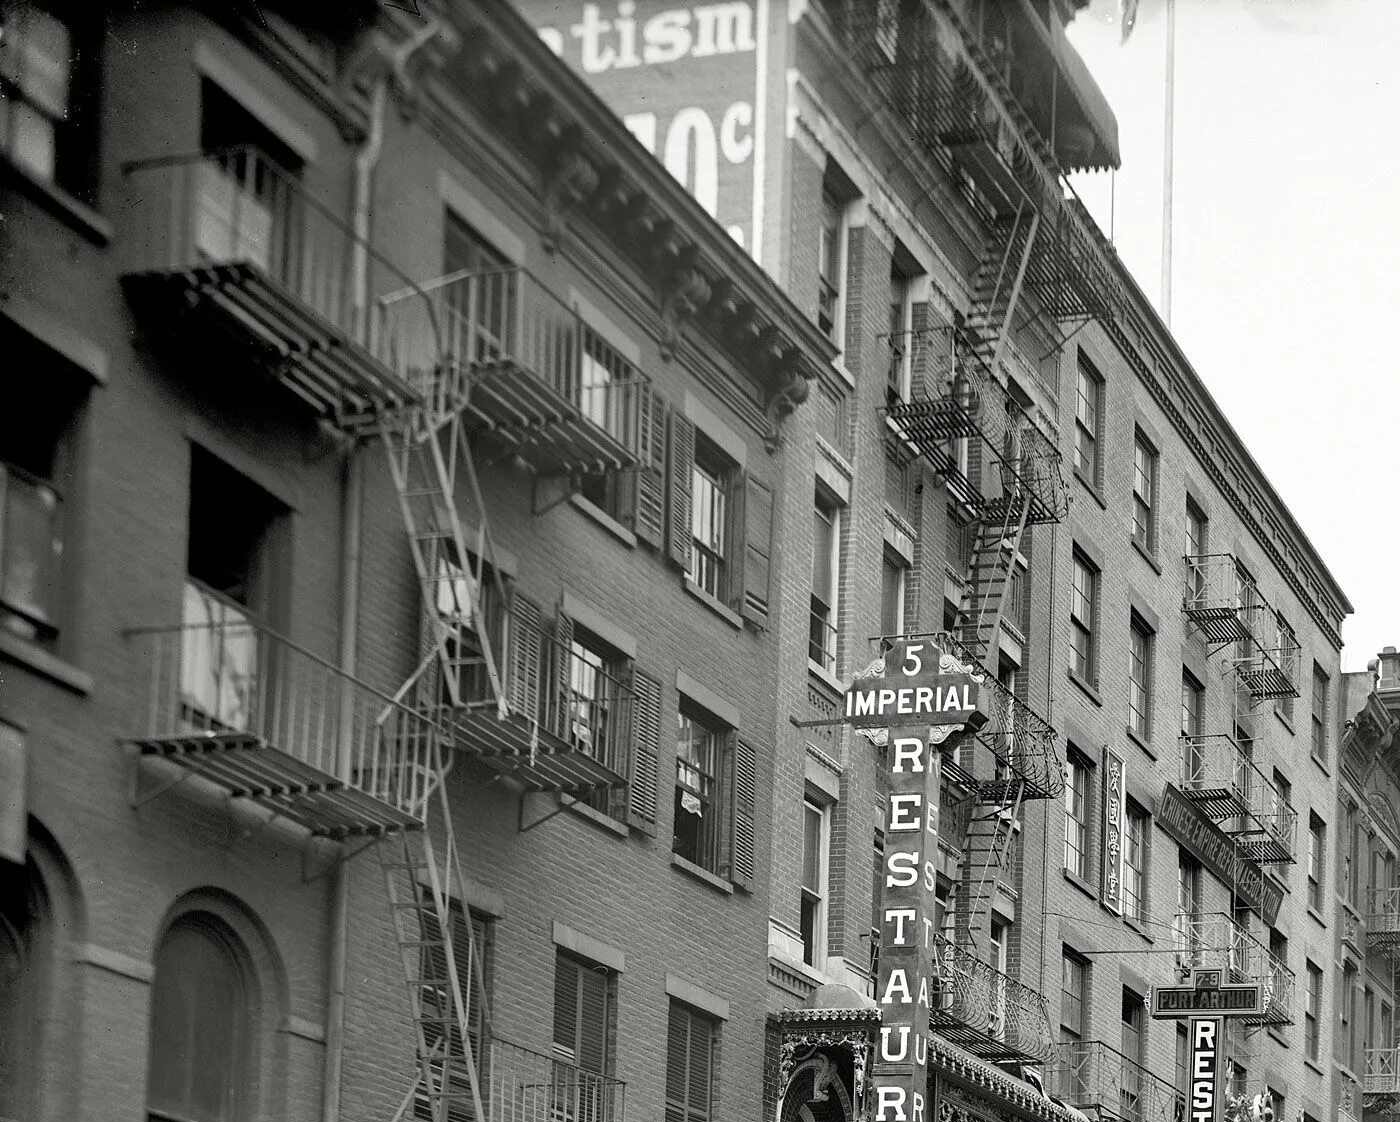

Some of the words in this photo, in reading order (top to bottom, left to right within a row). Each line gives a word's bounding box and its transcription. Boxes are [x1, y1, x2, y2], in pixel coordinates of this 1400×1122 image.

[902, 645, 923, 676] 5
[846, 684, 976, 717] IMPERIAL
[1162, 793, 1197, 839] CHINESE
[1192, 820, 1221, 862] EMPIRE
[1160, 990, 1196, 1008] PORT
[1199, 990, 1255, 1009] ARTHUR
